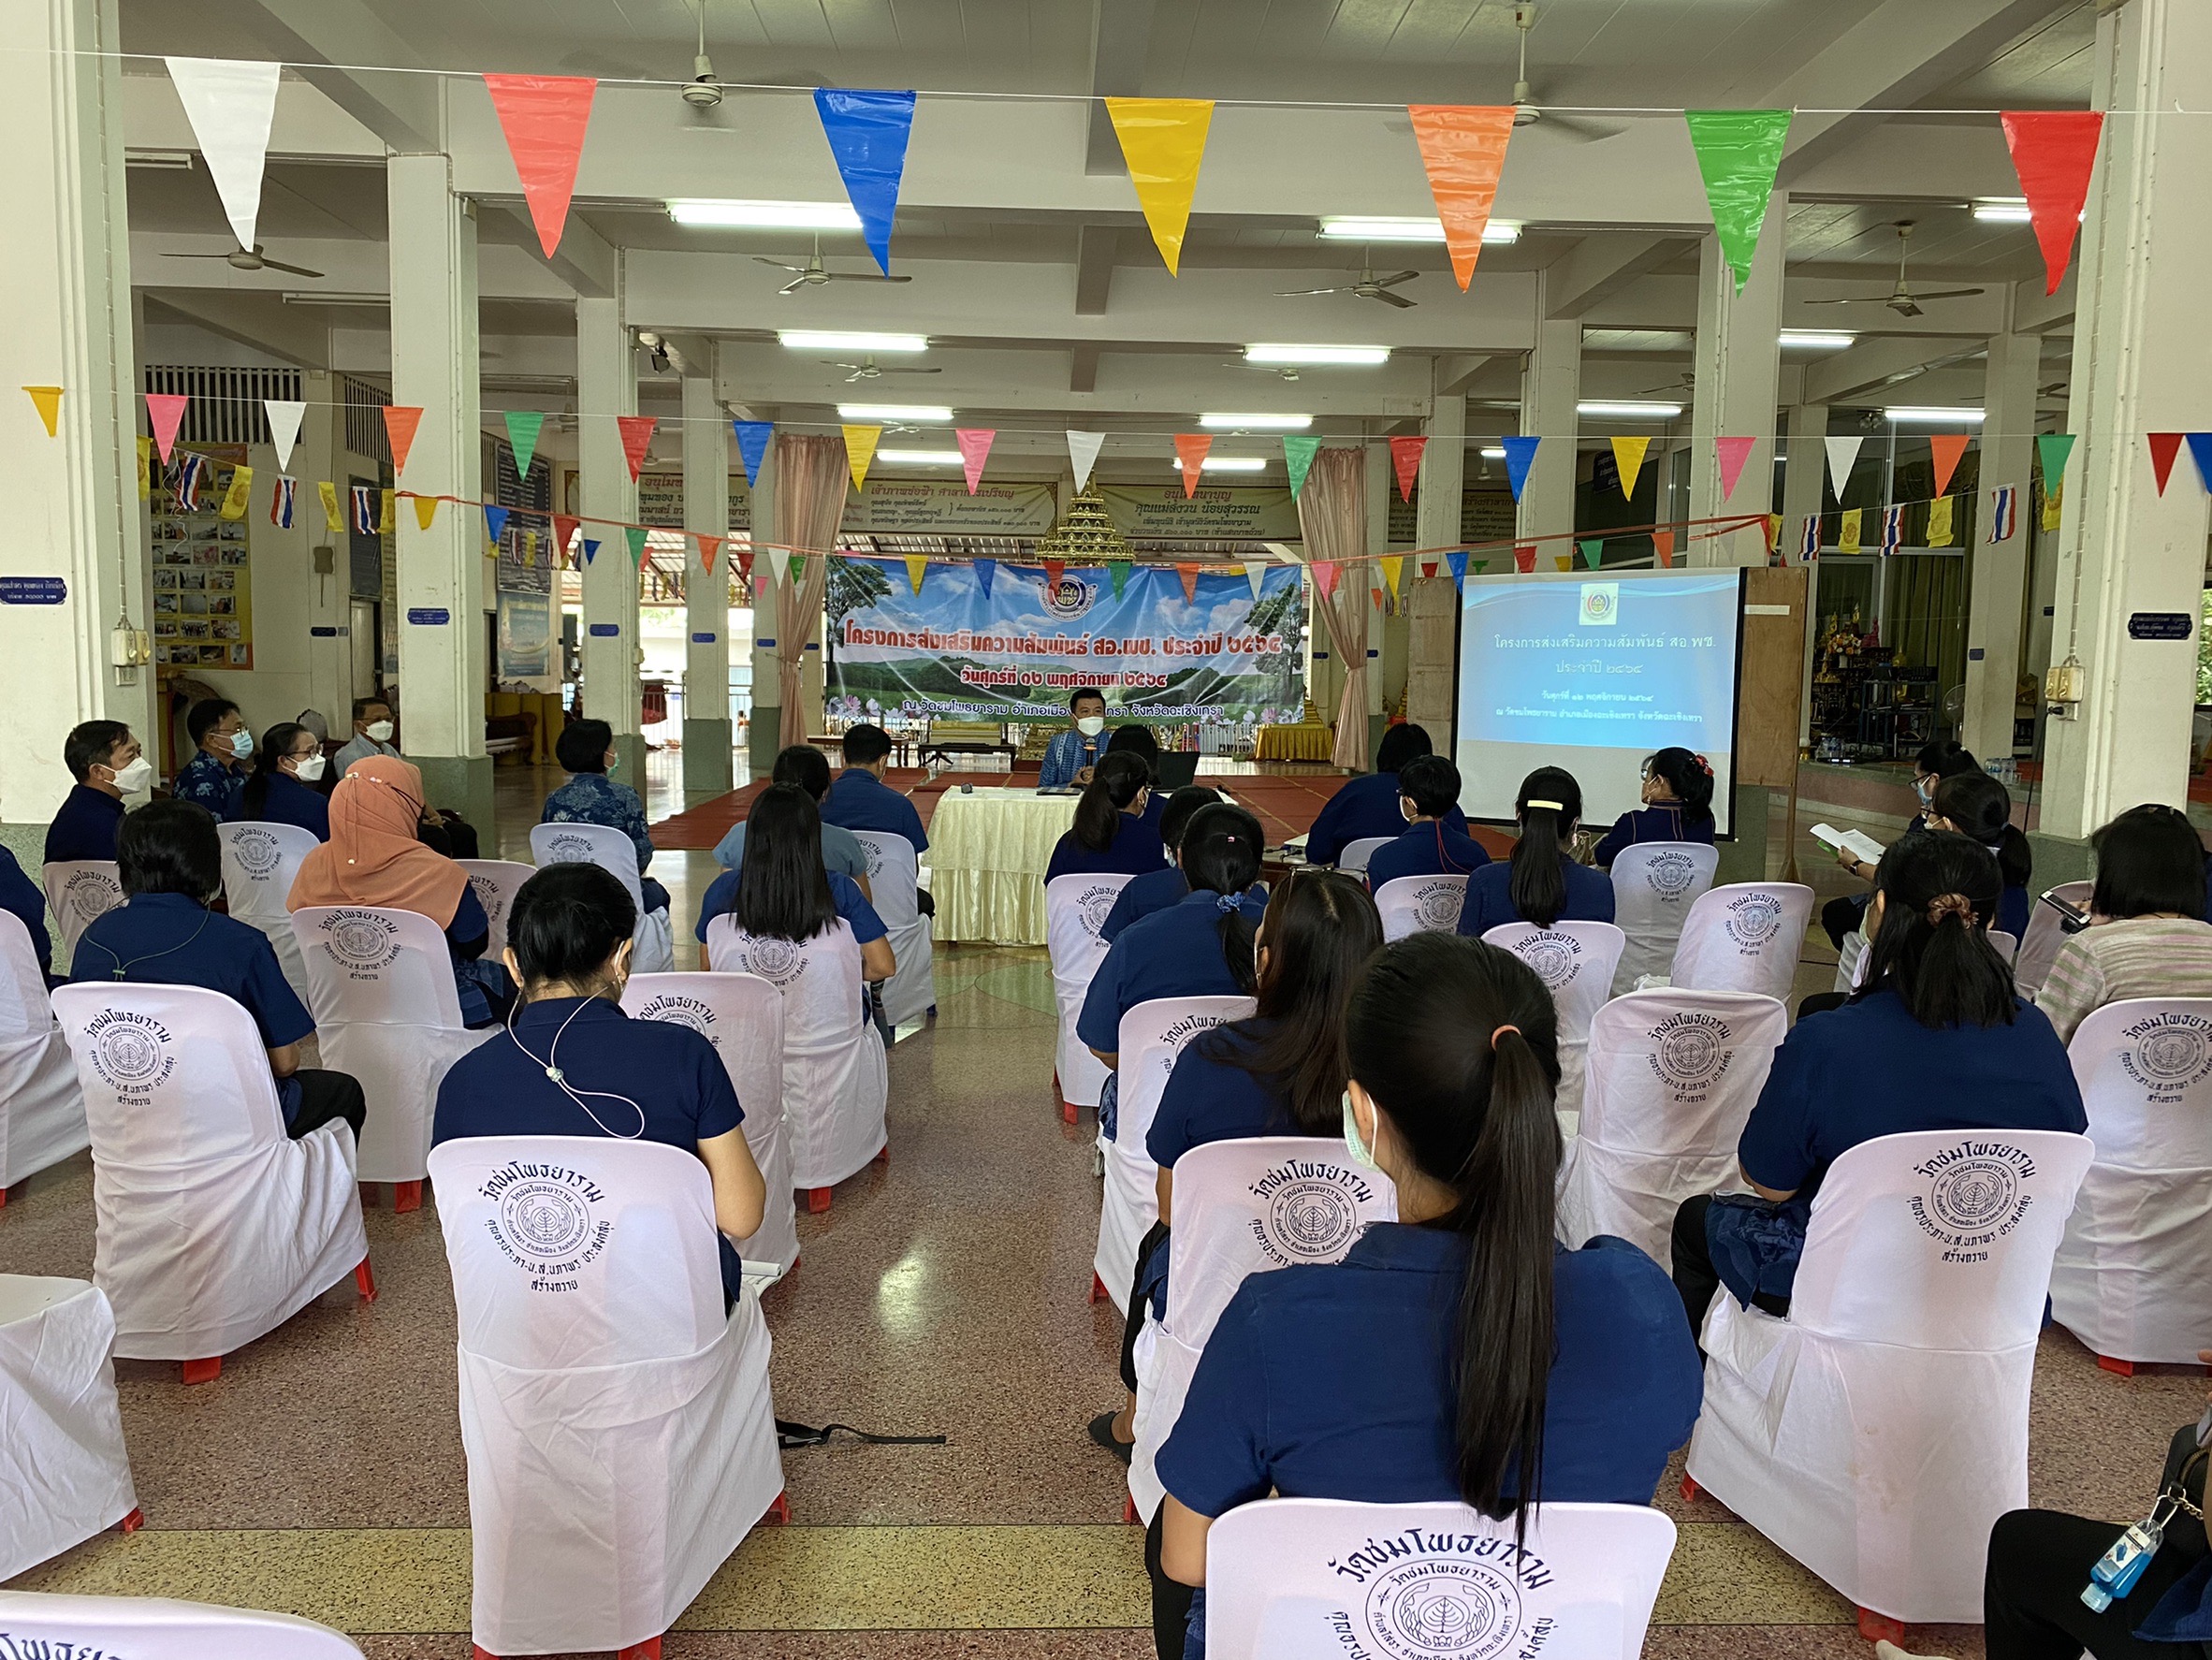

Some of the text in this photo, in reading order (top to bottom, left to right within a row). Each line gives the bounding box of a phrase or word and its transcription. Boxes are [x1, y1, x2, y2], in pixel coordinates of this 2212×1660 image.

[939, 487, 1014, 499] ศาลากรเปรียญ
[1164, 488, 1231, 502] อนุโทนาบุญ
[1201, 502, 1259, 517] น้อยสุวรรณ
[844, 619, 1284, 657] โครงการส่งเสริมความสัมพันธ์ สอ.พช. ประจำปี ๒๕๖๔
[1494, 632, 1665, 649] โครงการส่งเสริมความสัมพันธ์
[959, 663, 1169, 690] วันศุกร์ที่ ๑๒ พฤศจิกายน ๒๕๖๔
[1555, 659, 1603, 675] ประจำปี
[903, 700, 918, 712] ณ
[920, 698, 1008, 715] วัดชมโพธยาราม
[1131, 703, 1225, 719] จังหวัดฉะเชิงเทรา
[318, 909, 399, 934] วัดชมโพธยาราม
[1512, 931, 1581, 954] วัดชมโพธยาราม
[639, 995, 717, 1024] ดชมโพธยาราม
[83, 1008, 173, 1044] วัดชมโพธยาราม
[1647, 1012, 1732, 1041] วัดชมโพธยาราม
[1913, 1140, 2037, 1179] วัดชมโพธยาราม
[478, 1160, 605, 1203] วัดชมโพธยาราม
[1248, 1158, 1374, 1203] วัดชมโพธยาราม
[1942, 1247, 1988, 1263] สร้างถวาย
[531, 1276, 579, 1292] สร้างถวาย
[1328, 1527, 1555, 1591] วัดชมโพธยาราม
[1390, 1563, 1502, 1591] วัดชมโพธยาราม
